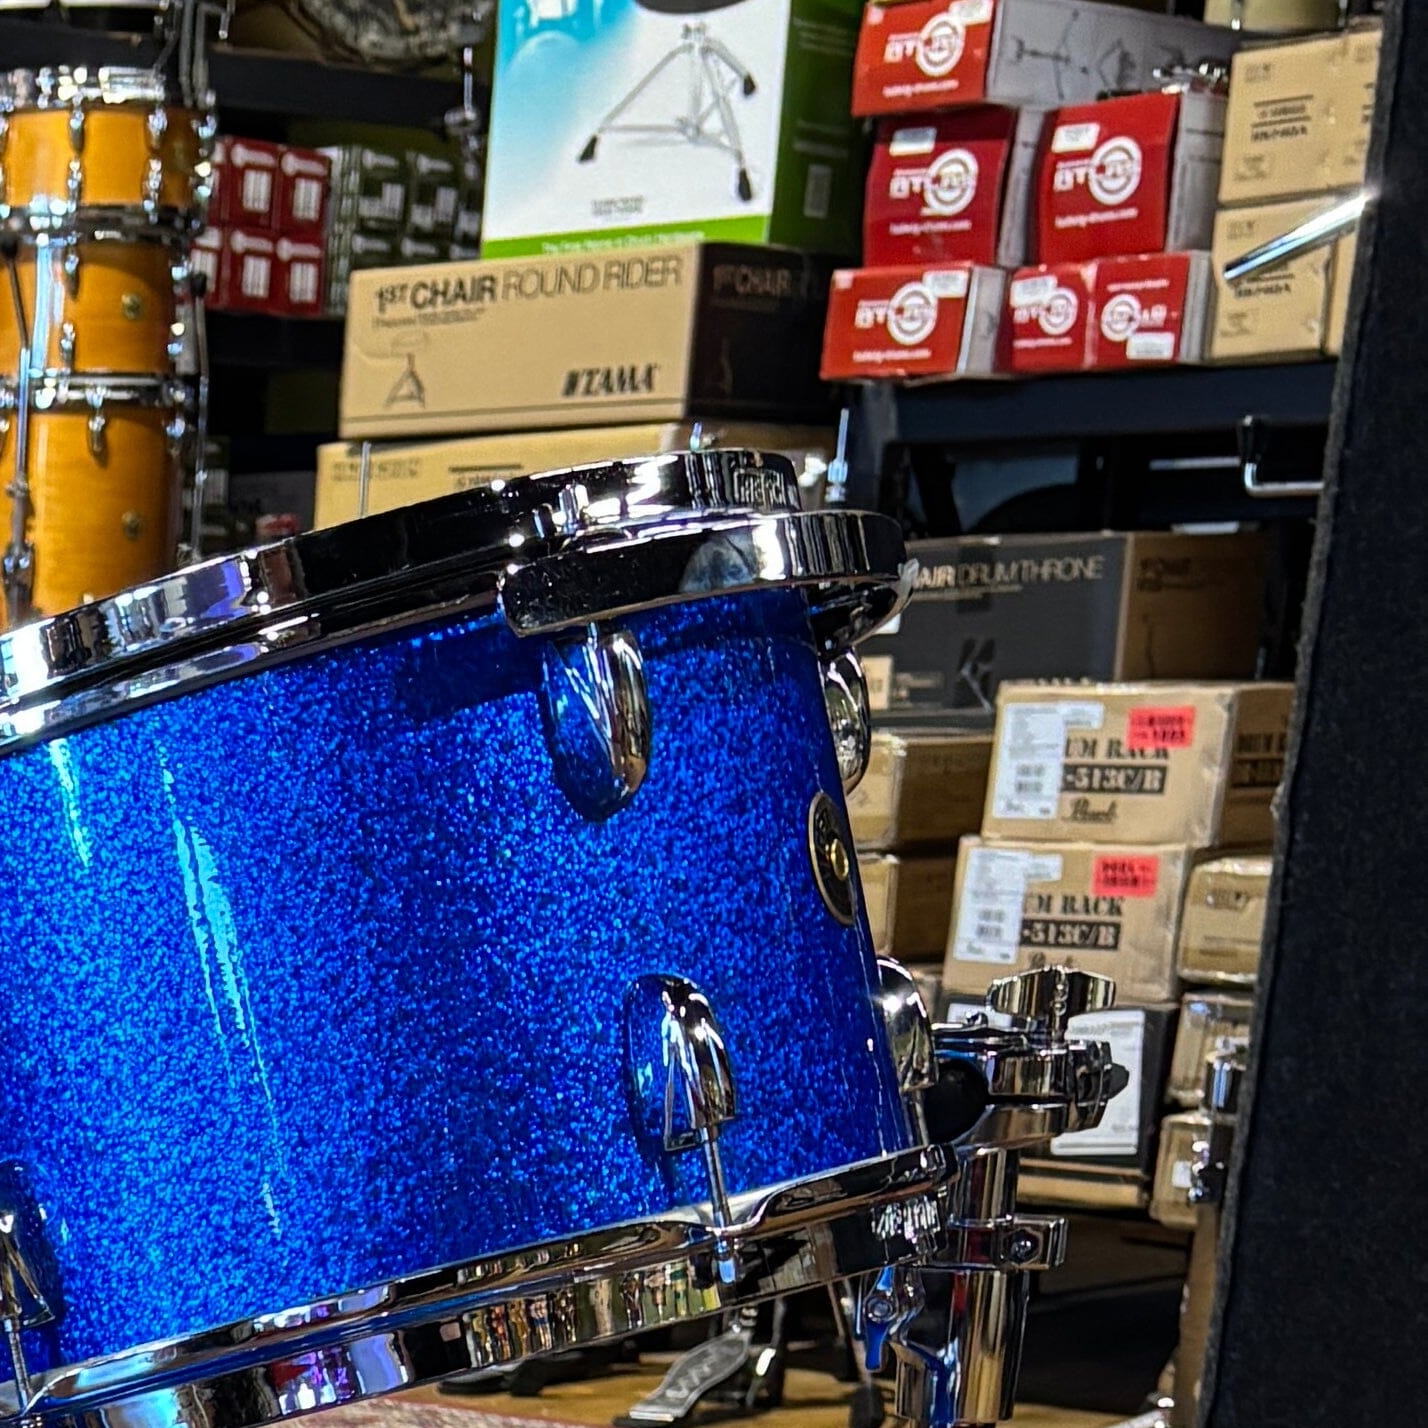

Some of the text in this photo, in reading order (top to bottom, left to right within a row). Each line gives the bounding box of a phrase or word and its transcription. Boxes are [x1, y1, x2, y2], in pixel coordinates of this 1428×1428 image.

[409, 274, 499, 310] CHAIR
[501, 262, 601, 301] ROUND
[602, 253, 683, 291] RIDER
[1018, 553, 1106, 583] THRONE
